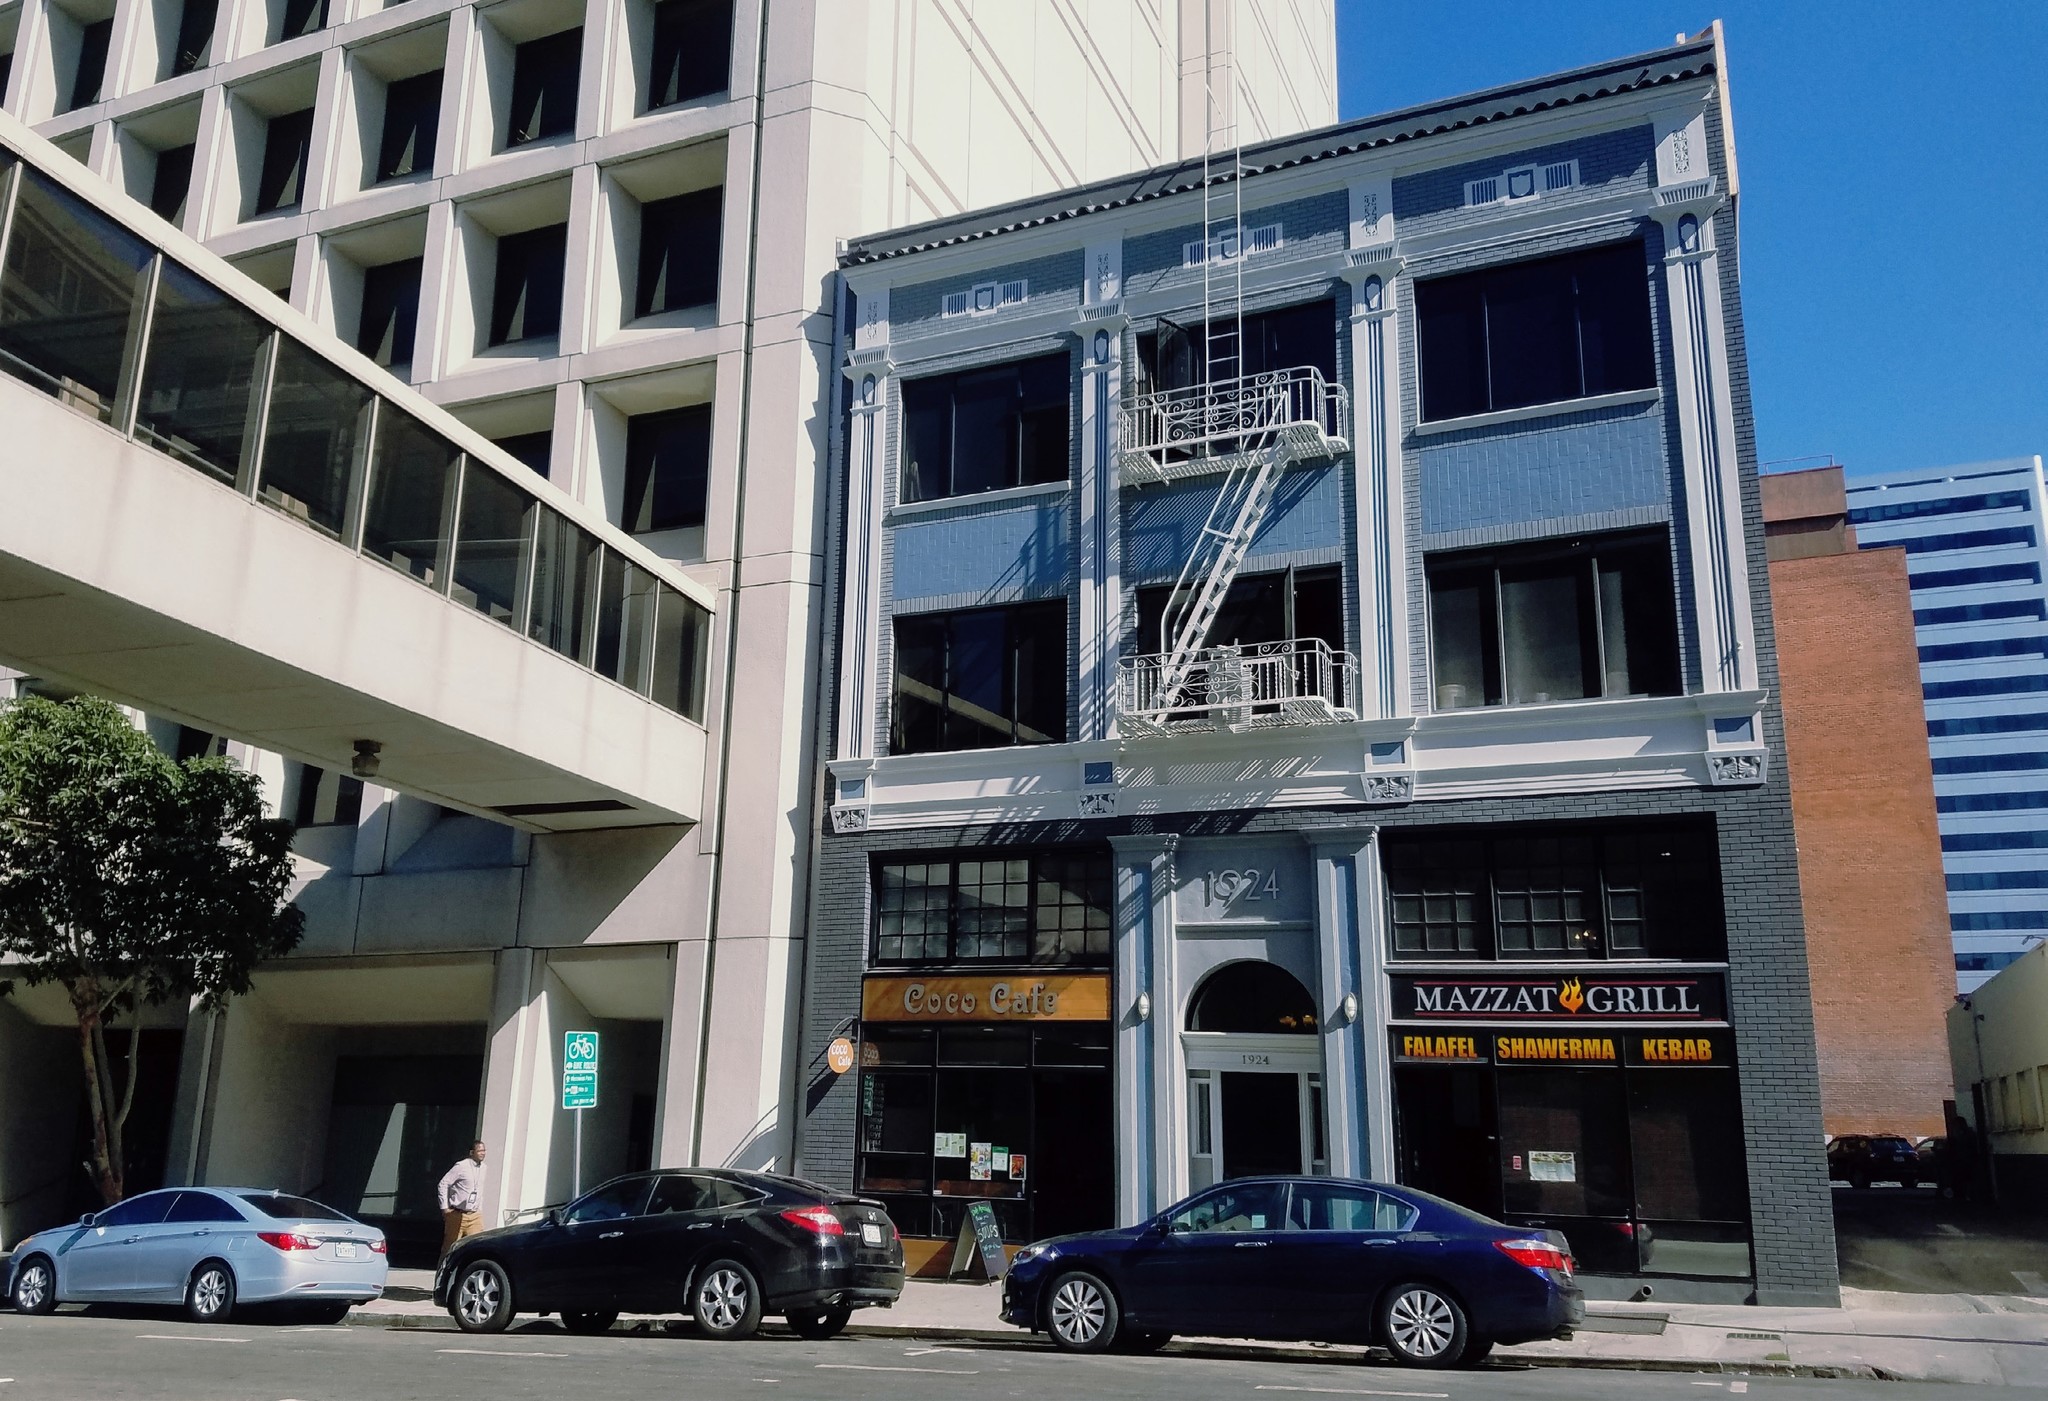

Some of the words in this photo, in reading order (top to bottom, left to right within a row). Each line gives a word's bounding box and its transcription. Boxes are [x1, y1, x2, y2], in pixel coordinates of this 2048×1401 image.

[1206, 868, 1280, 902] 1924
[904, 983, 977, 1015] Coco
[989, 982, 1059, 1014] Cafe
[1414, 986, 1557, 1012] MAZZAT
[1586, 985, 1701, 1013] GRILL
[1403, 1036, 1478, 1058] FALAFEL
[1497, 1037, 1616, 1060] SHAWERMA
[1642, 1038, 1712, 1061] KEBAB
[1242, 1055, 1270, 1065] 1924
